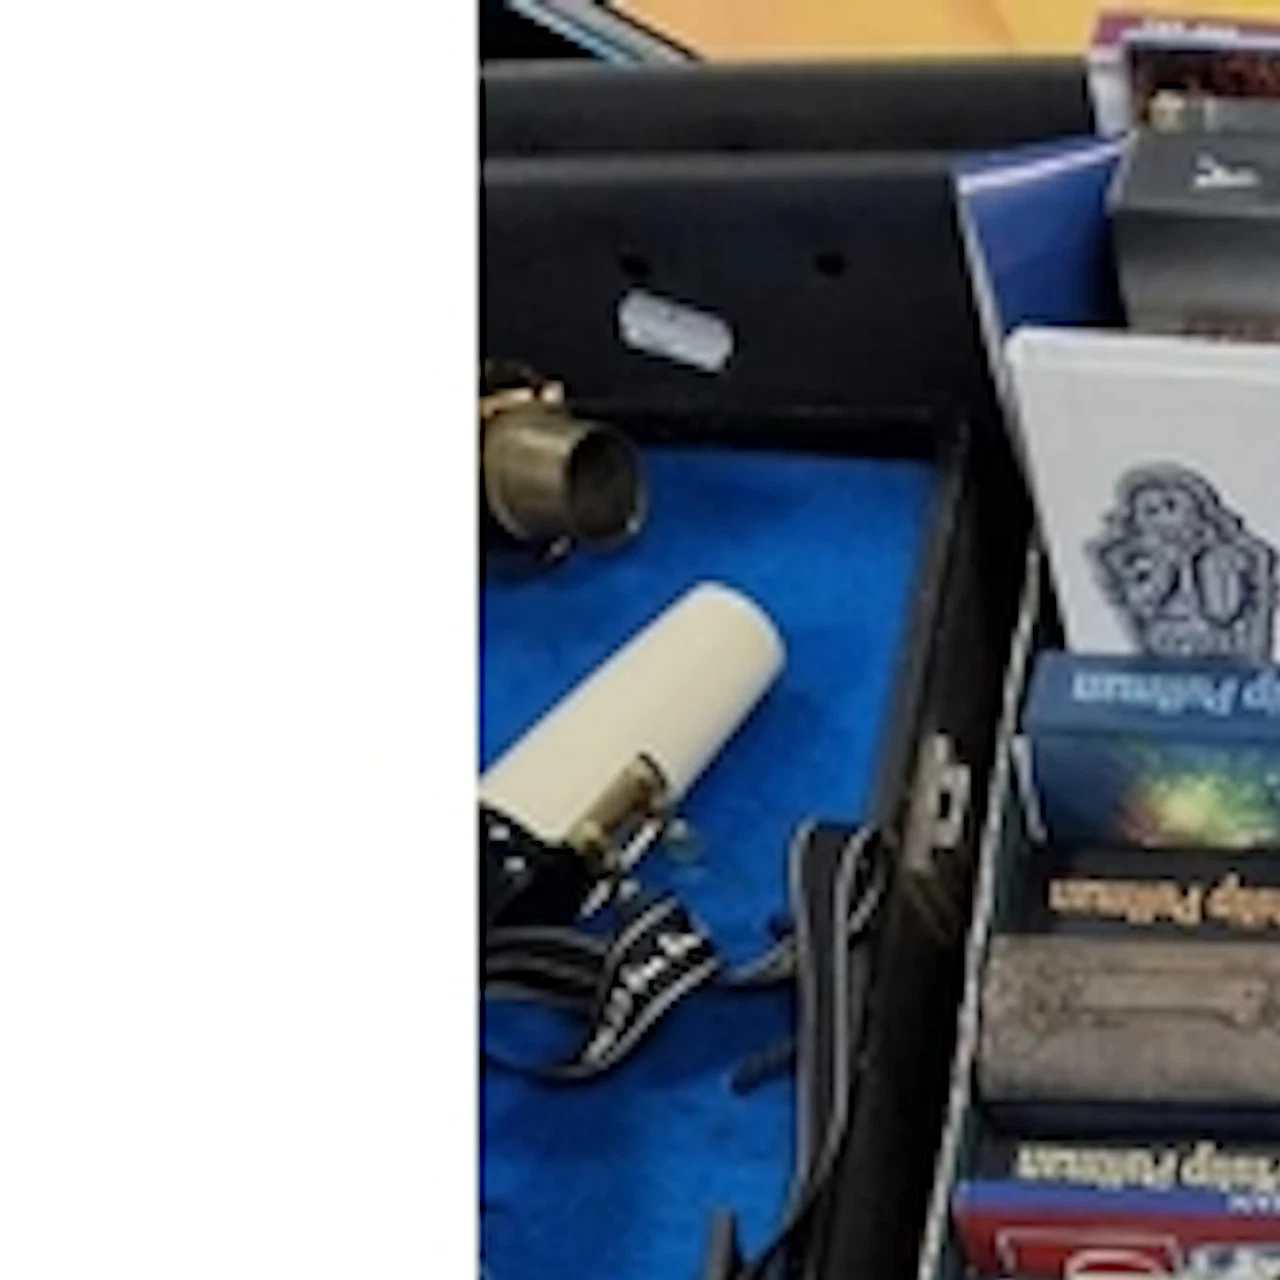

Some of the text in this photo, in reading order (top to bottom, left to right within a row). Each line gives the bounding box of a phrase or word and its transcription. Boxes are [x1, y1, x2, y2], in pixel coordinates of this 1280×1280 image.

[1071, 669, 1238, 712] Pullman
[1049, 877, 1201, 918] Pullman
[1017, 1145, 1174, 1184] Pullman
